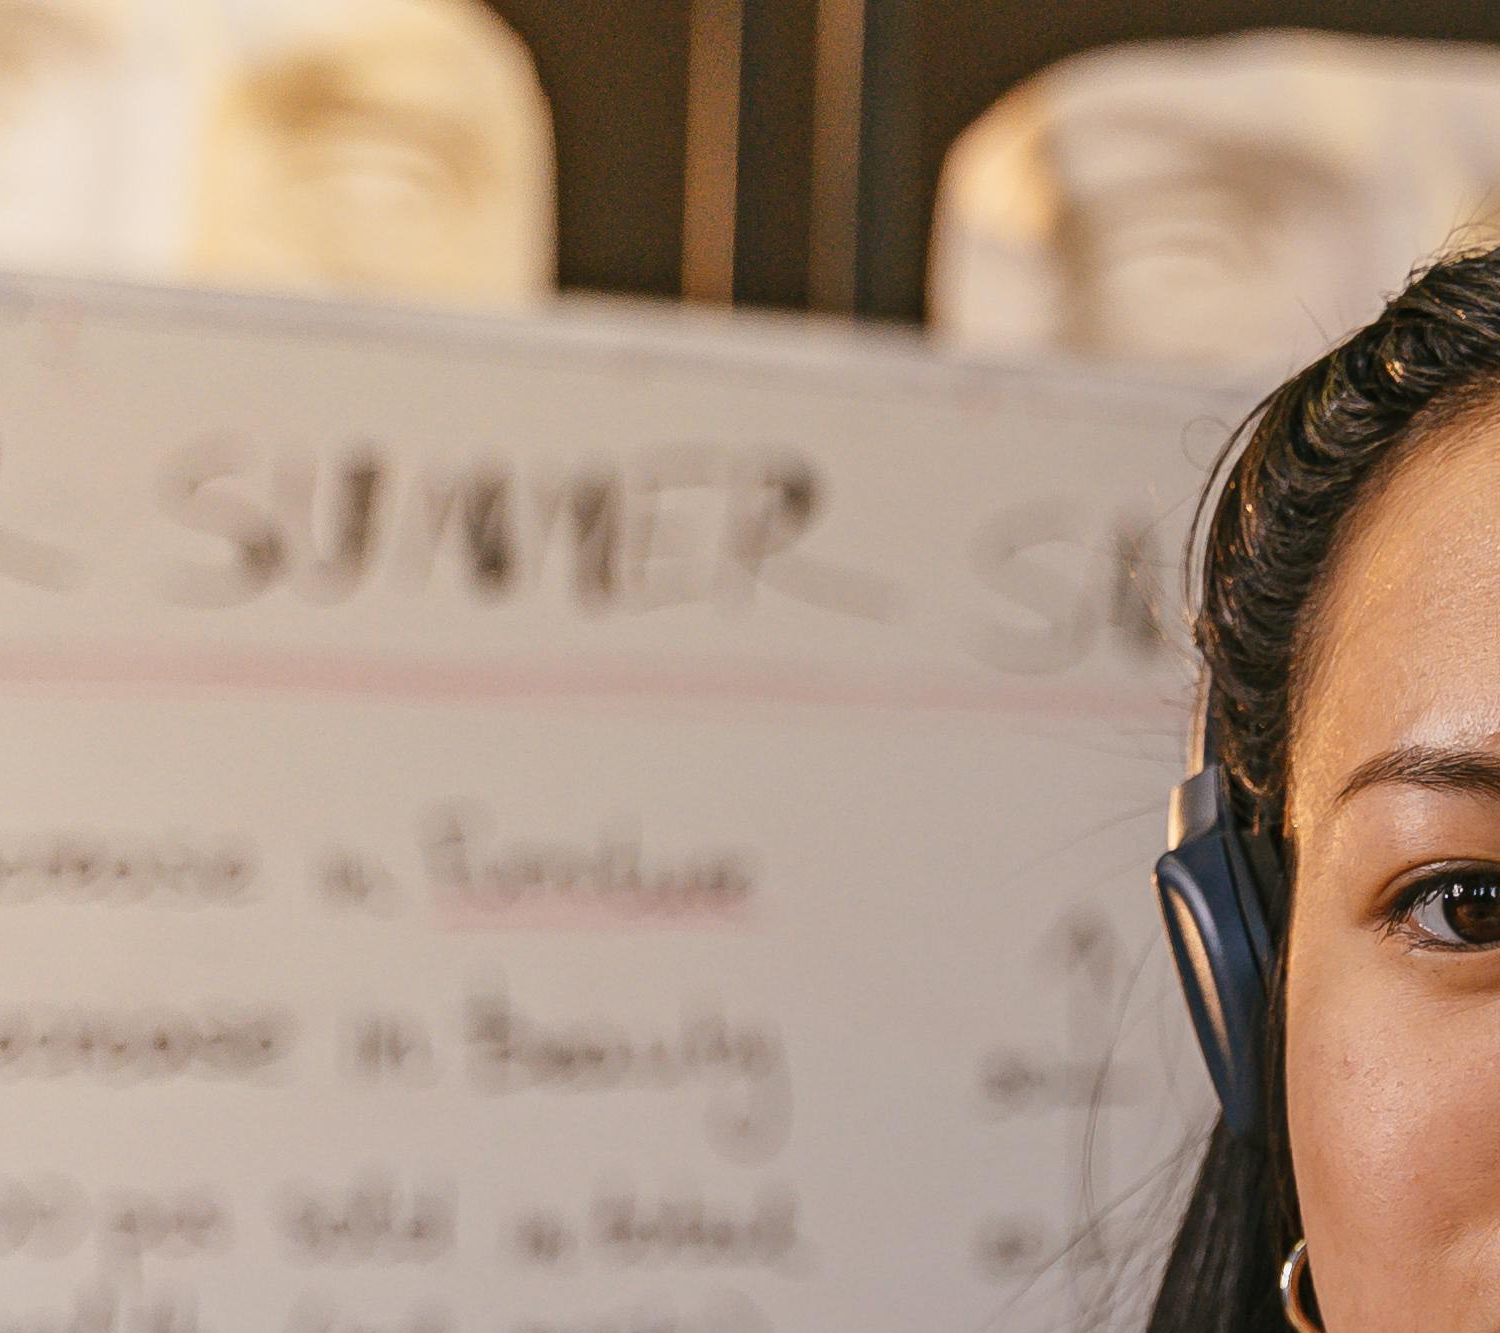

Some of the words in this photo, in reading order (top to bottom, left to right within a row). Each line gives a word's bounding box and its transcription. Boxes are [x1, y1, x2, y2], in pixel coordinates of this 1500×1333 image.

[158, 432, 900, 624] SUMMER
[316, 842, 396, 914] in
[340, 1000, 426, 1084] in
[457, 972, 788, 1158] Beauty
[275, 1168, 452, 1264] sold
